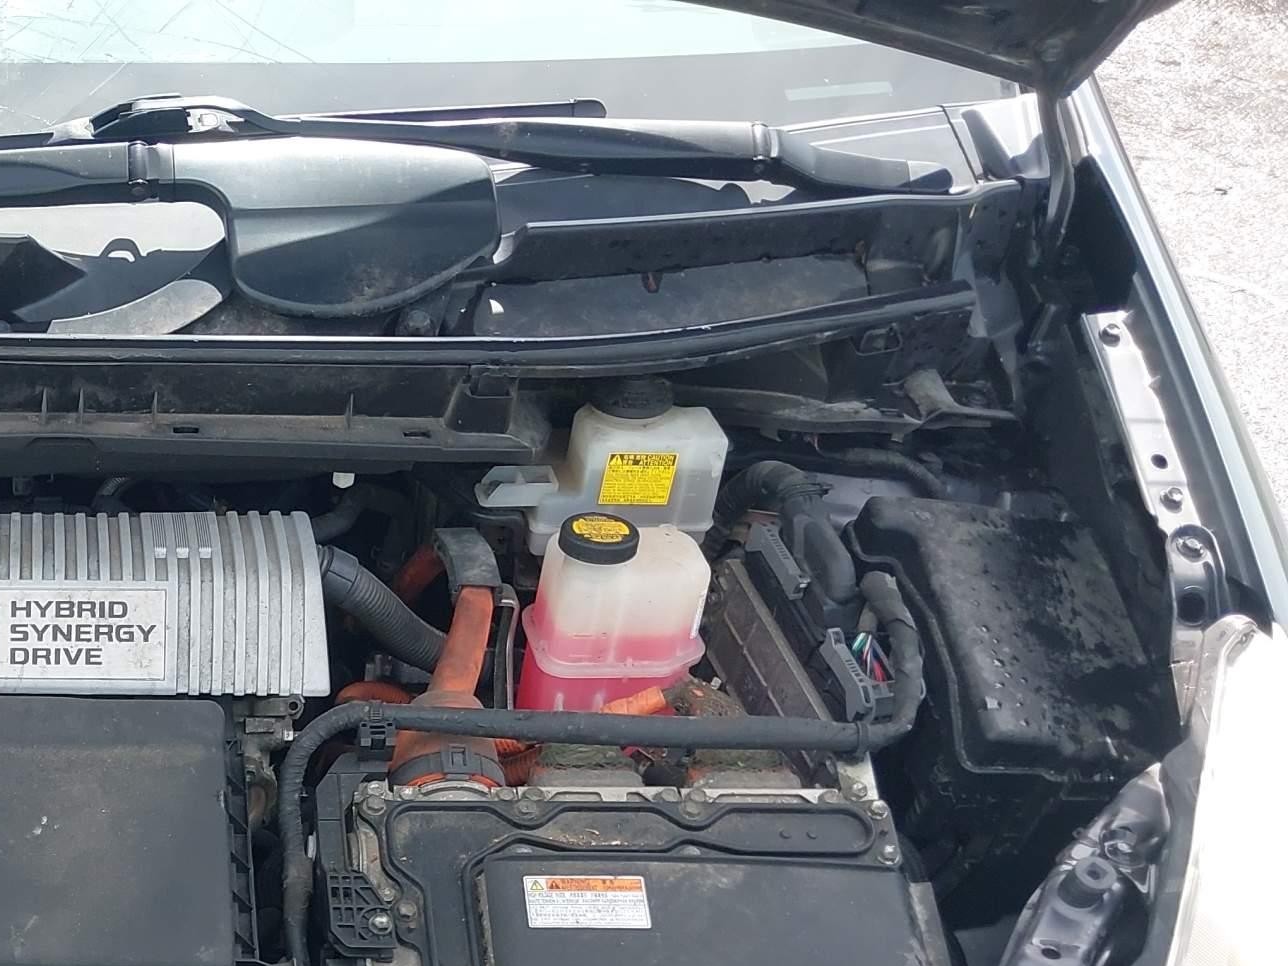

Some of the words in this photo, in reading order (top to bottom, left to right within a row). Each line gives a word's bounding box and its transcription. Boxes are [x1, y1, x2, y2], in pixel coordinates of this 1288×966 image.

[11, 600, 128, 618] HYBRID
[10, 624, 157, 642] SYNERGY
[10, 648, 103, 665] DRIVE
